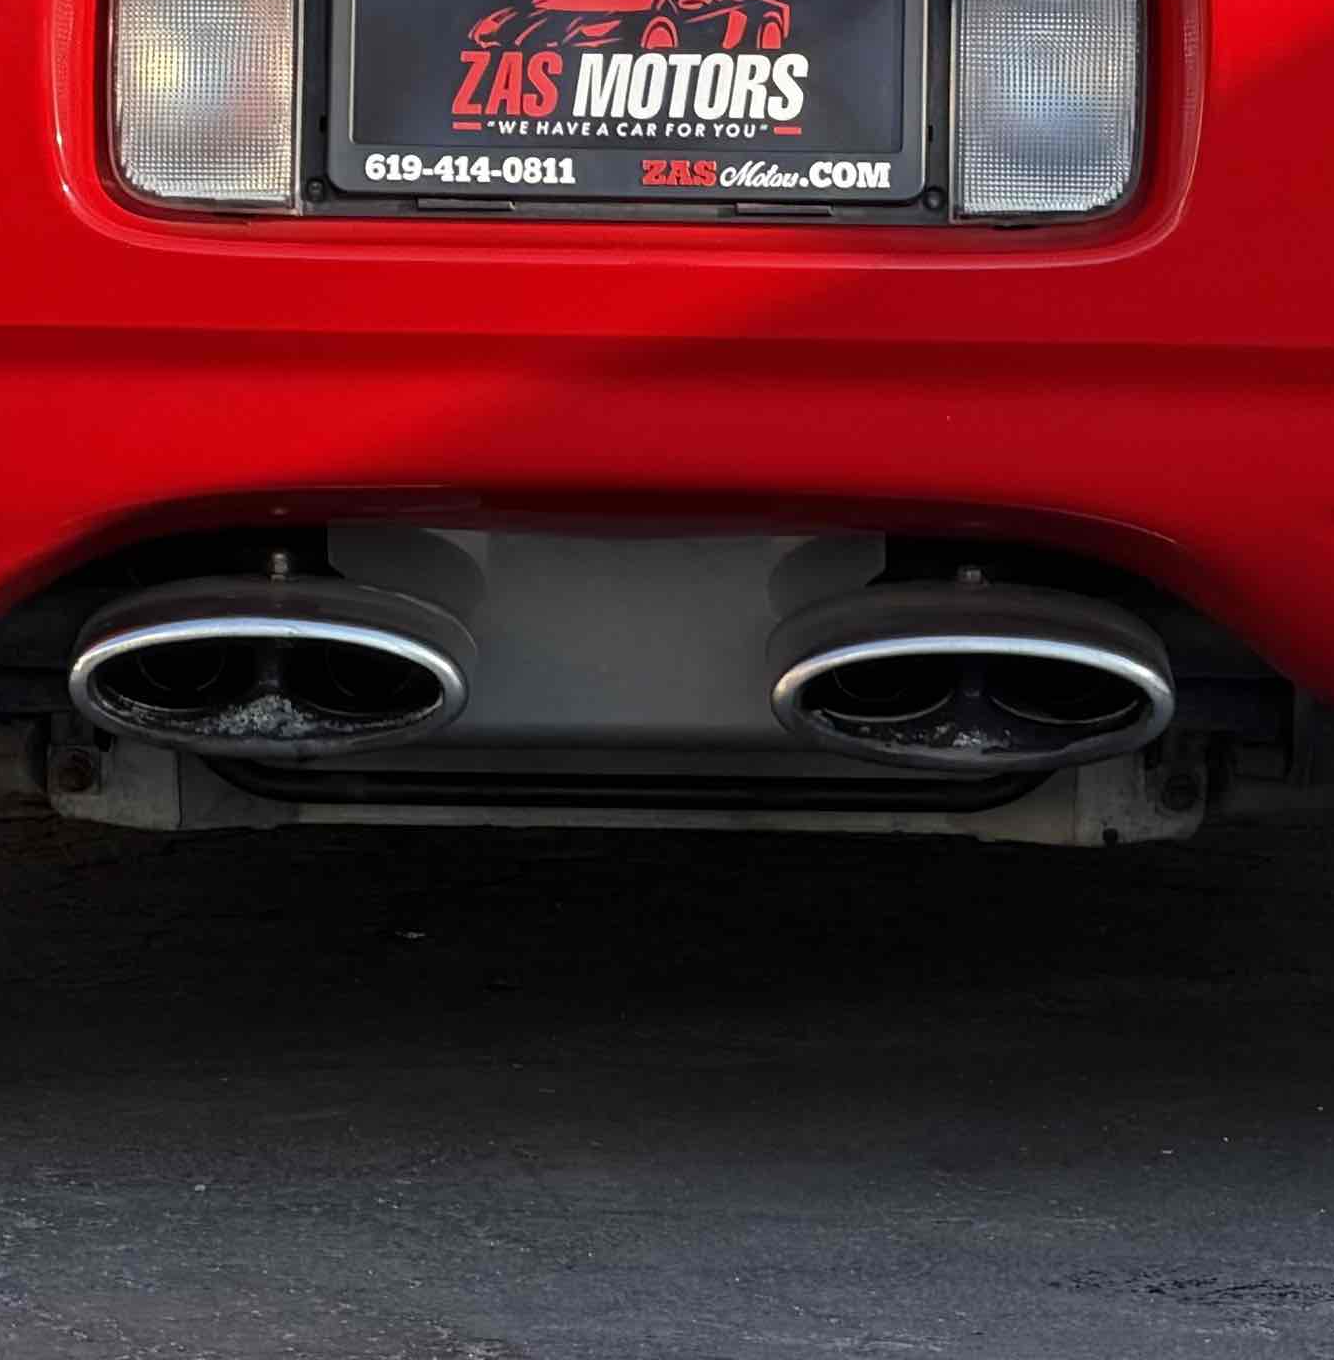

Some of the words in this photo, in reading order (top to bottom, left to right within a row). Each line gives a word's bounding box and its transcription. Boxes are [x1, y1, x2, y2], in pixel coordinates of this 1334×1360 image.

[451, 51, 564, 117] ZAS
[572, 53, 809, 121] MOTORS
[535, 121, 590, 137] HAVE
[596, 122, 610, 137] A
[616, 122, 658, 137] CAR
[665, 122, 706, 138] FOR
[365, 153, 576, 185] 619-414-0811
[642, 159, 717, 187] ZAS
